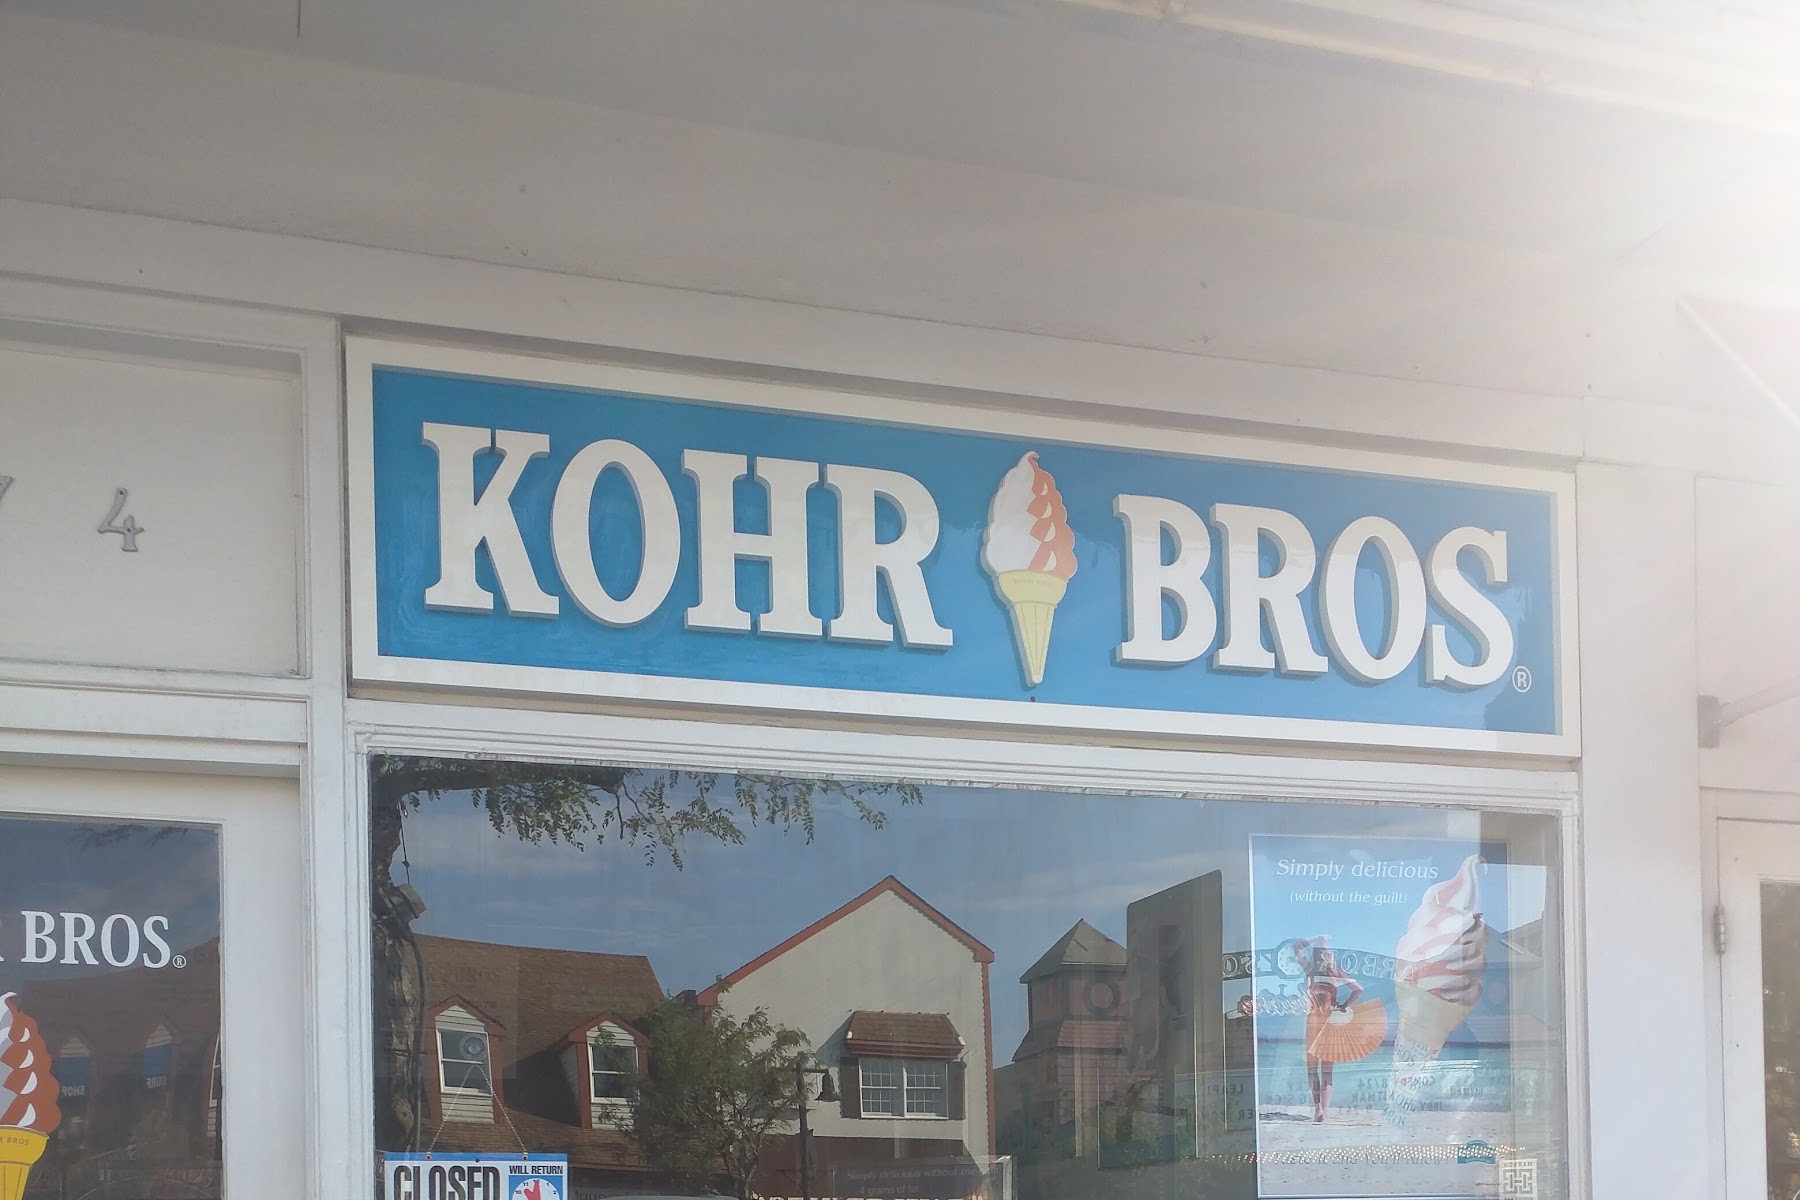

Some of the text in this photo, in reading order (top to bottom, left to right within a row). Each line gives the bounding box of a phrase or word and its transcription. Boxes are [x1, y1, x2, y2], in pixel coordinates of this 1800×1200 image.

[97, 487, 144, 553] 4
[421, 421, 1514, 689] KOHR BROS
[1276, 859, 1439, 881] Simply delicious
[1289, 889, 1408, 907] (without the guilt)
[20, 910, 171, 968] BROS
[509, 1165, 564, 1174] WILL RETURN
[847, 1170, 877, 1181] Simply
[879, 1169, 920, 1179] delicious
[867, 1187, 894, 1196] grams
